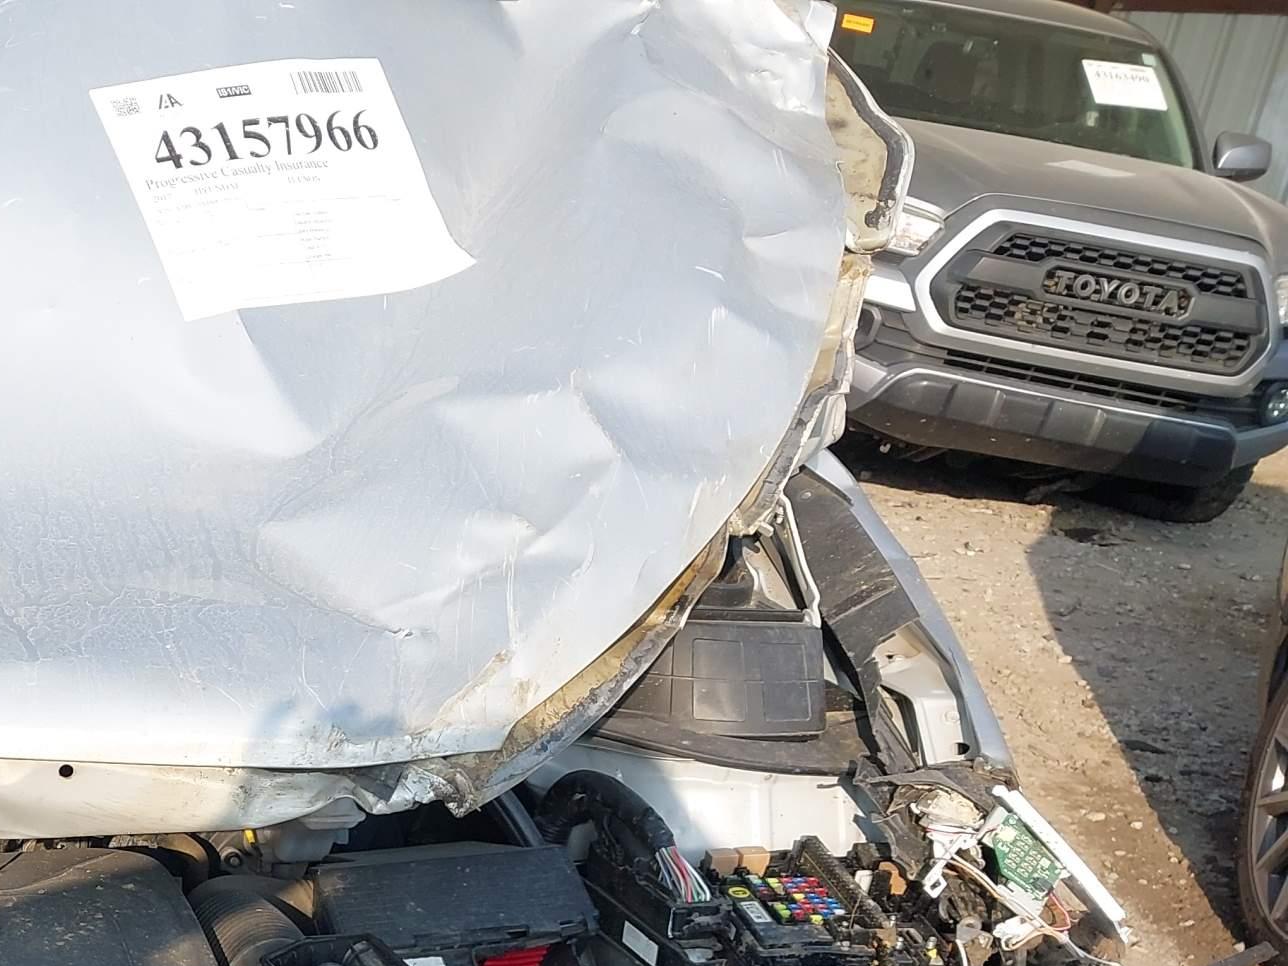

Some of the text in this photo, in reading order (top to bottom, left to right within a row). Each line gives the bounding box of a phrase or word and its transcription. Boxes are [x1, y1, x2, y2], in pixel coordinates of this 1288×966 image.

[155, 109, 379, 169] 43157966
[144, 159, 329, 191] Progressive Casualty Insurance
[1055, 270, 1179, 317] TOYOTA
